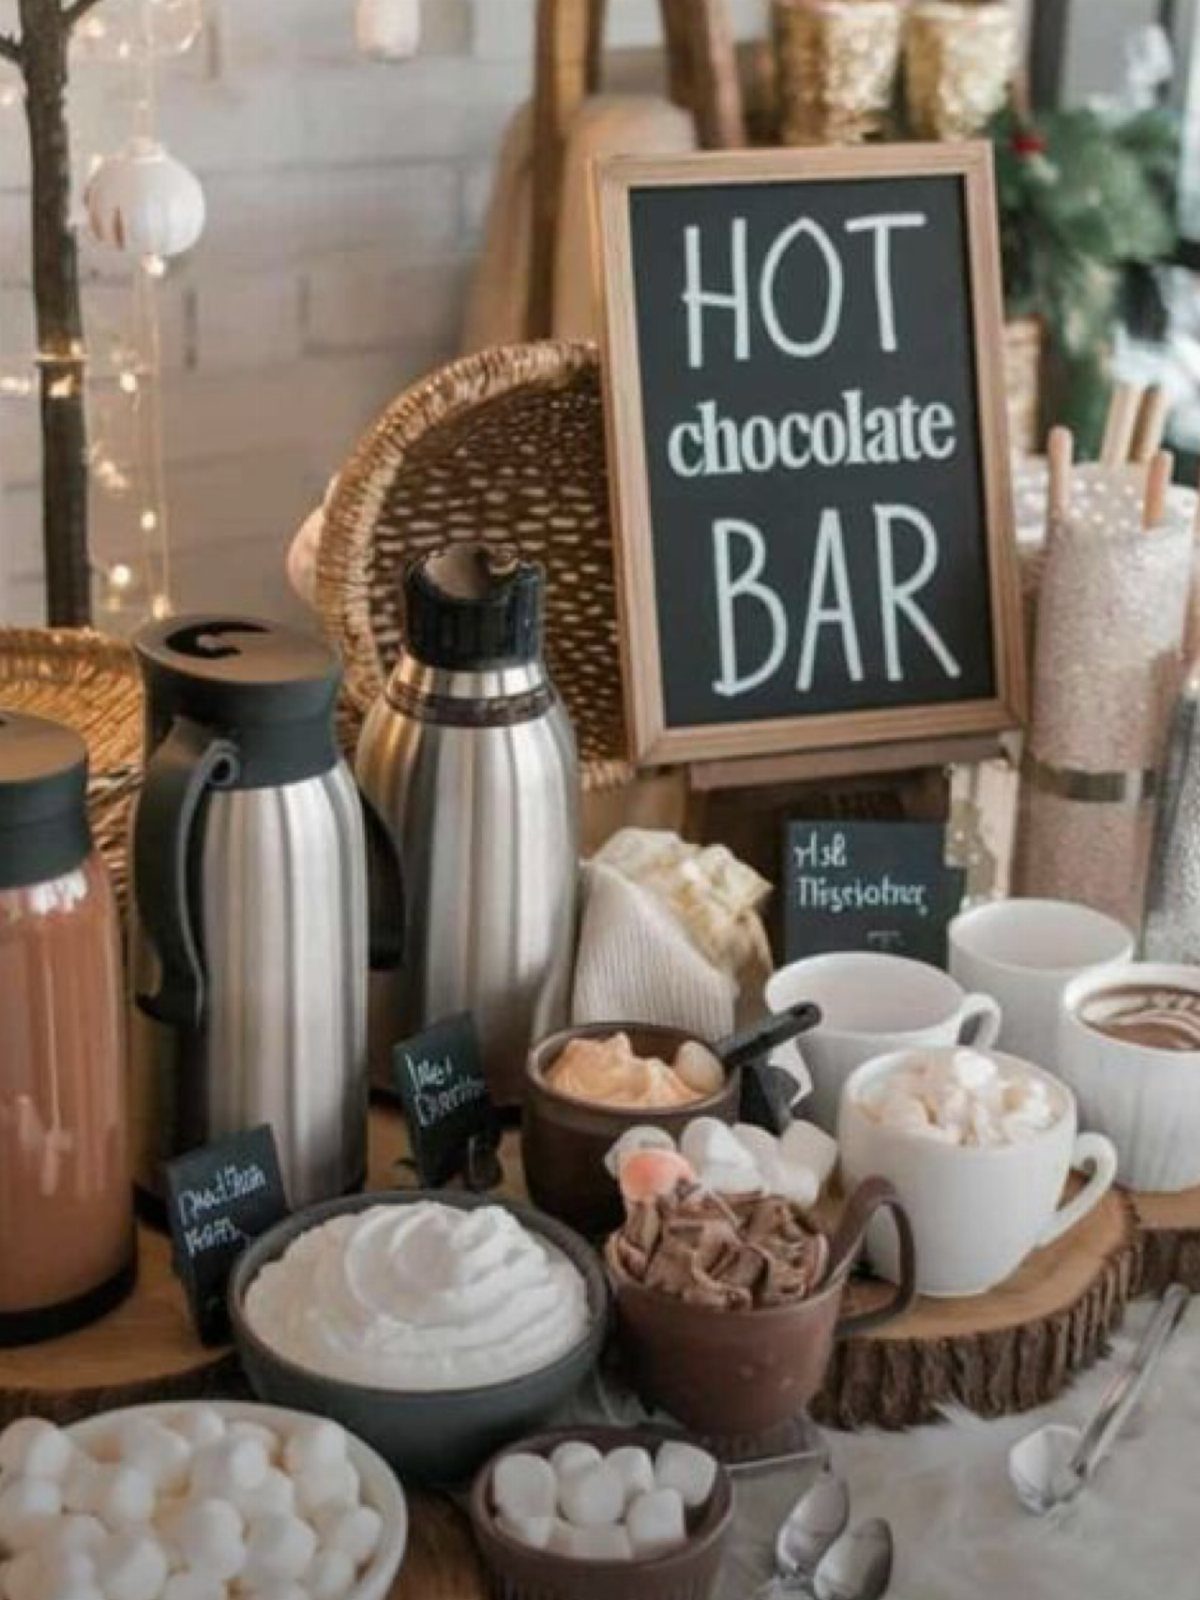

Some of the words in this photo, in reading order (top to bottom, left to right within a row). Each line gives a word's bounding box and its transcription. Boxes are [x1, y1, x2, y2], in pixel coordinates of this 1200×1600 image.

[682, 212, 927, 369] HOT
[667, 388, 957, 478] chocolate
[712, 503, 962, 697] BAR
